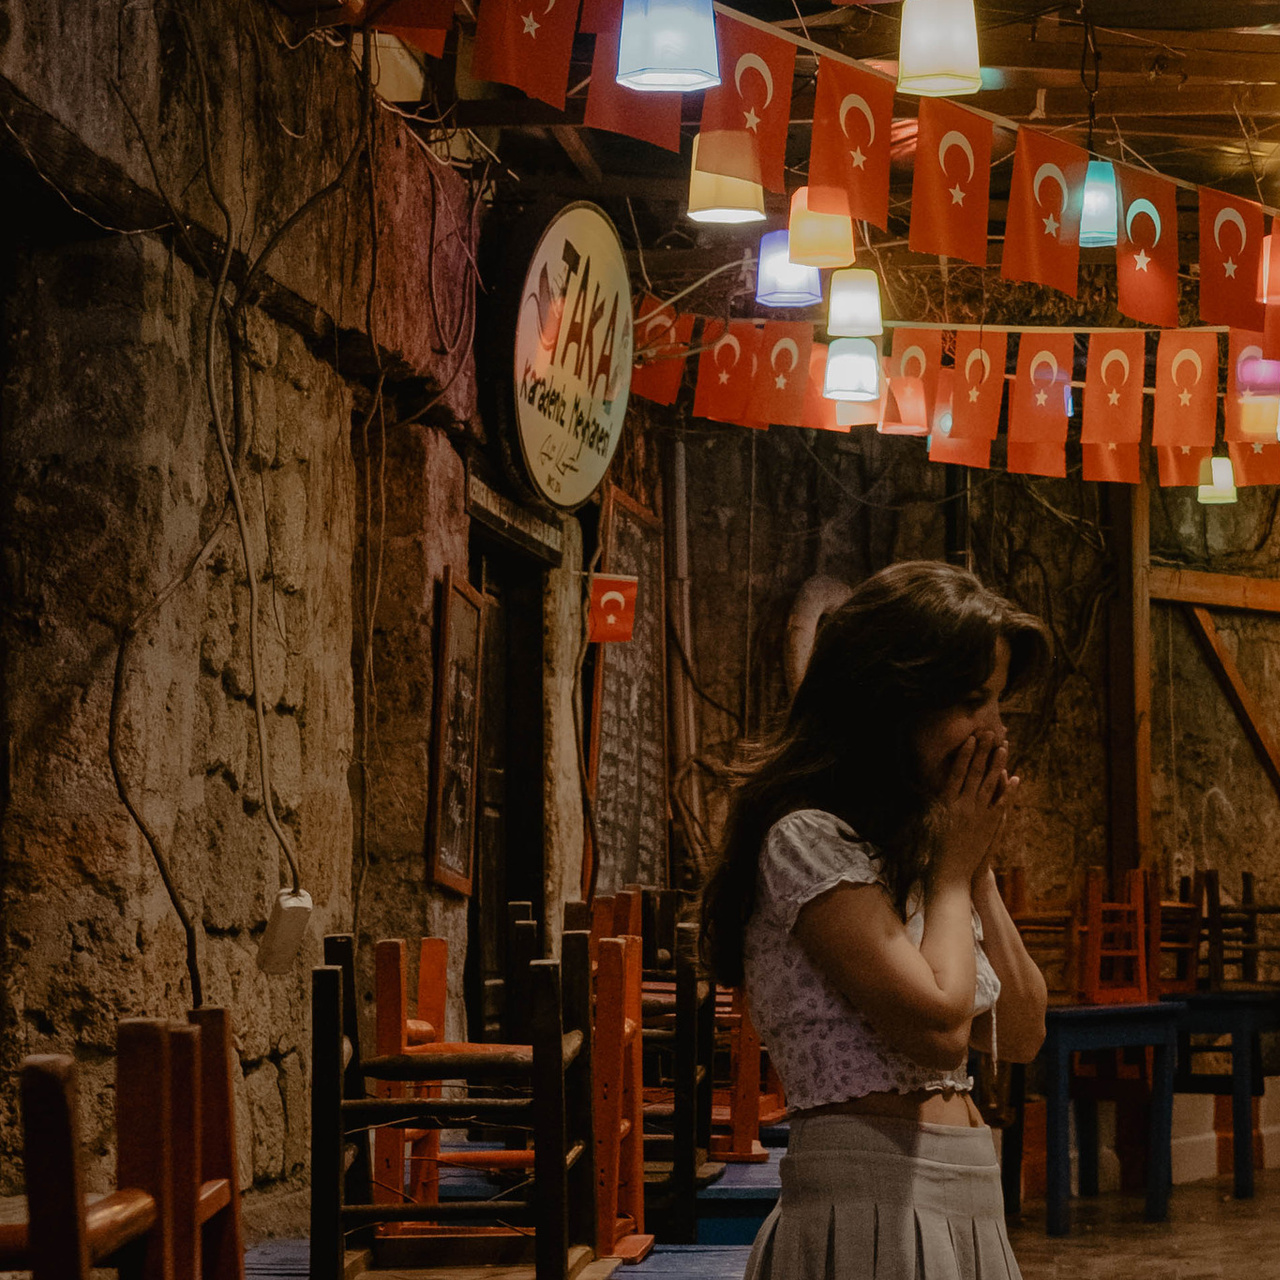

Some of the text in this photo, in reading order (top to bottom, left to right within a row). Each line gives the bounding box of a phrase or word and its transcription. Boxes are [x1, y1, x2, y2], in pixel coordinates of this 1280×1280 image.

[549, 238, 619, 407] TAKA
[519, 357, 567, 429] Karadeniz
[567, 392, 613, 462] Meyhanesi
